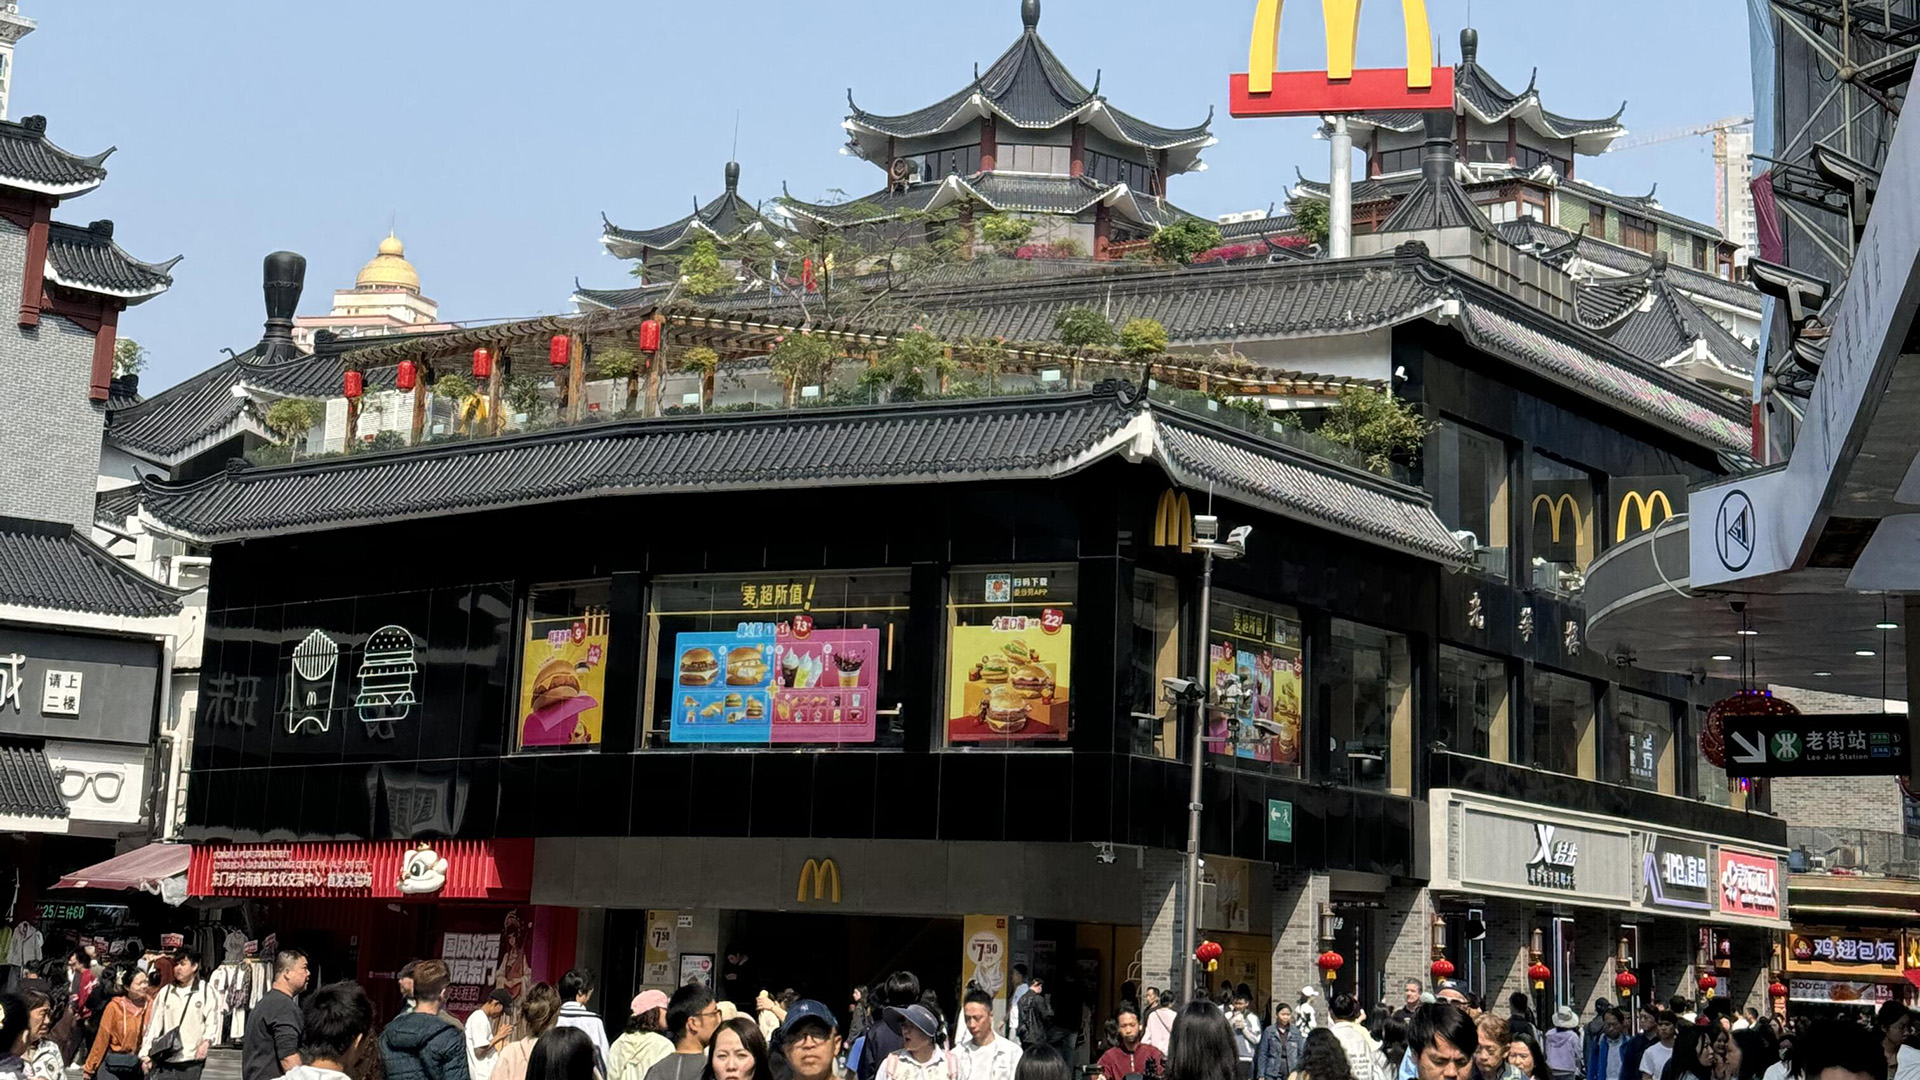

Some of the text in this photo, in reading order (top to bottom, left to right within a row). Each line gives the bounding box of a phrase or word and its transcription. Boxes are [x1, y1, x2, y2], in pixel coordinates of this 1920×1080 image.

[49, 673, 78, 689] 请上
[47, 695, 76, 711] 二楼
[1806, 730, 1867, 750] 老街站
[1806, 753, 1869, 761] Lao Jie Station
[1813, 938, 1897, 961] 鸡翅包饭
